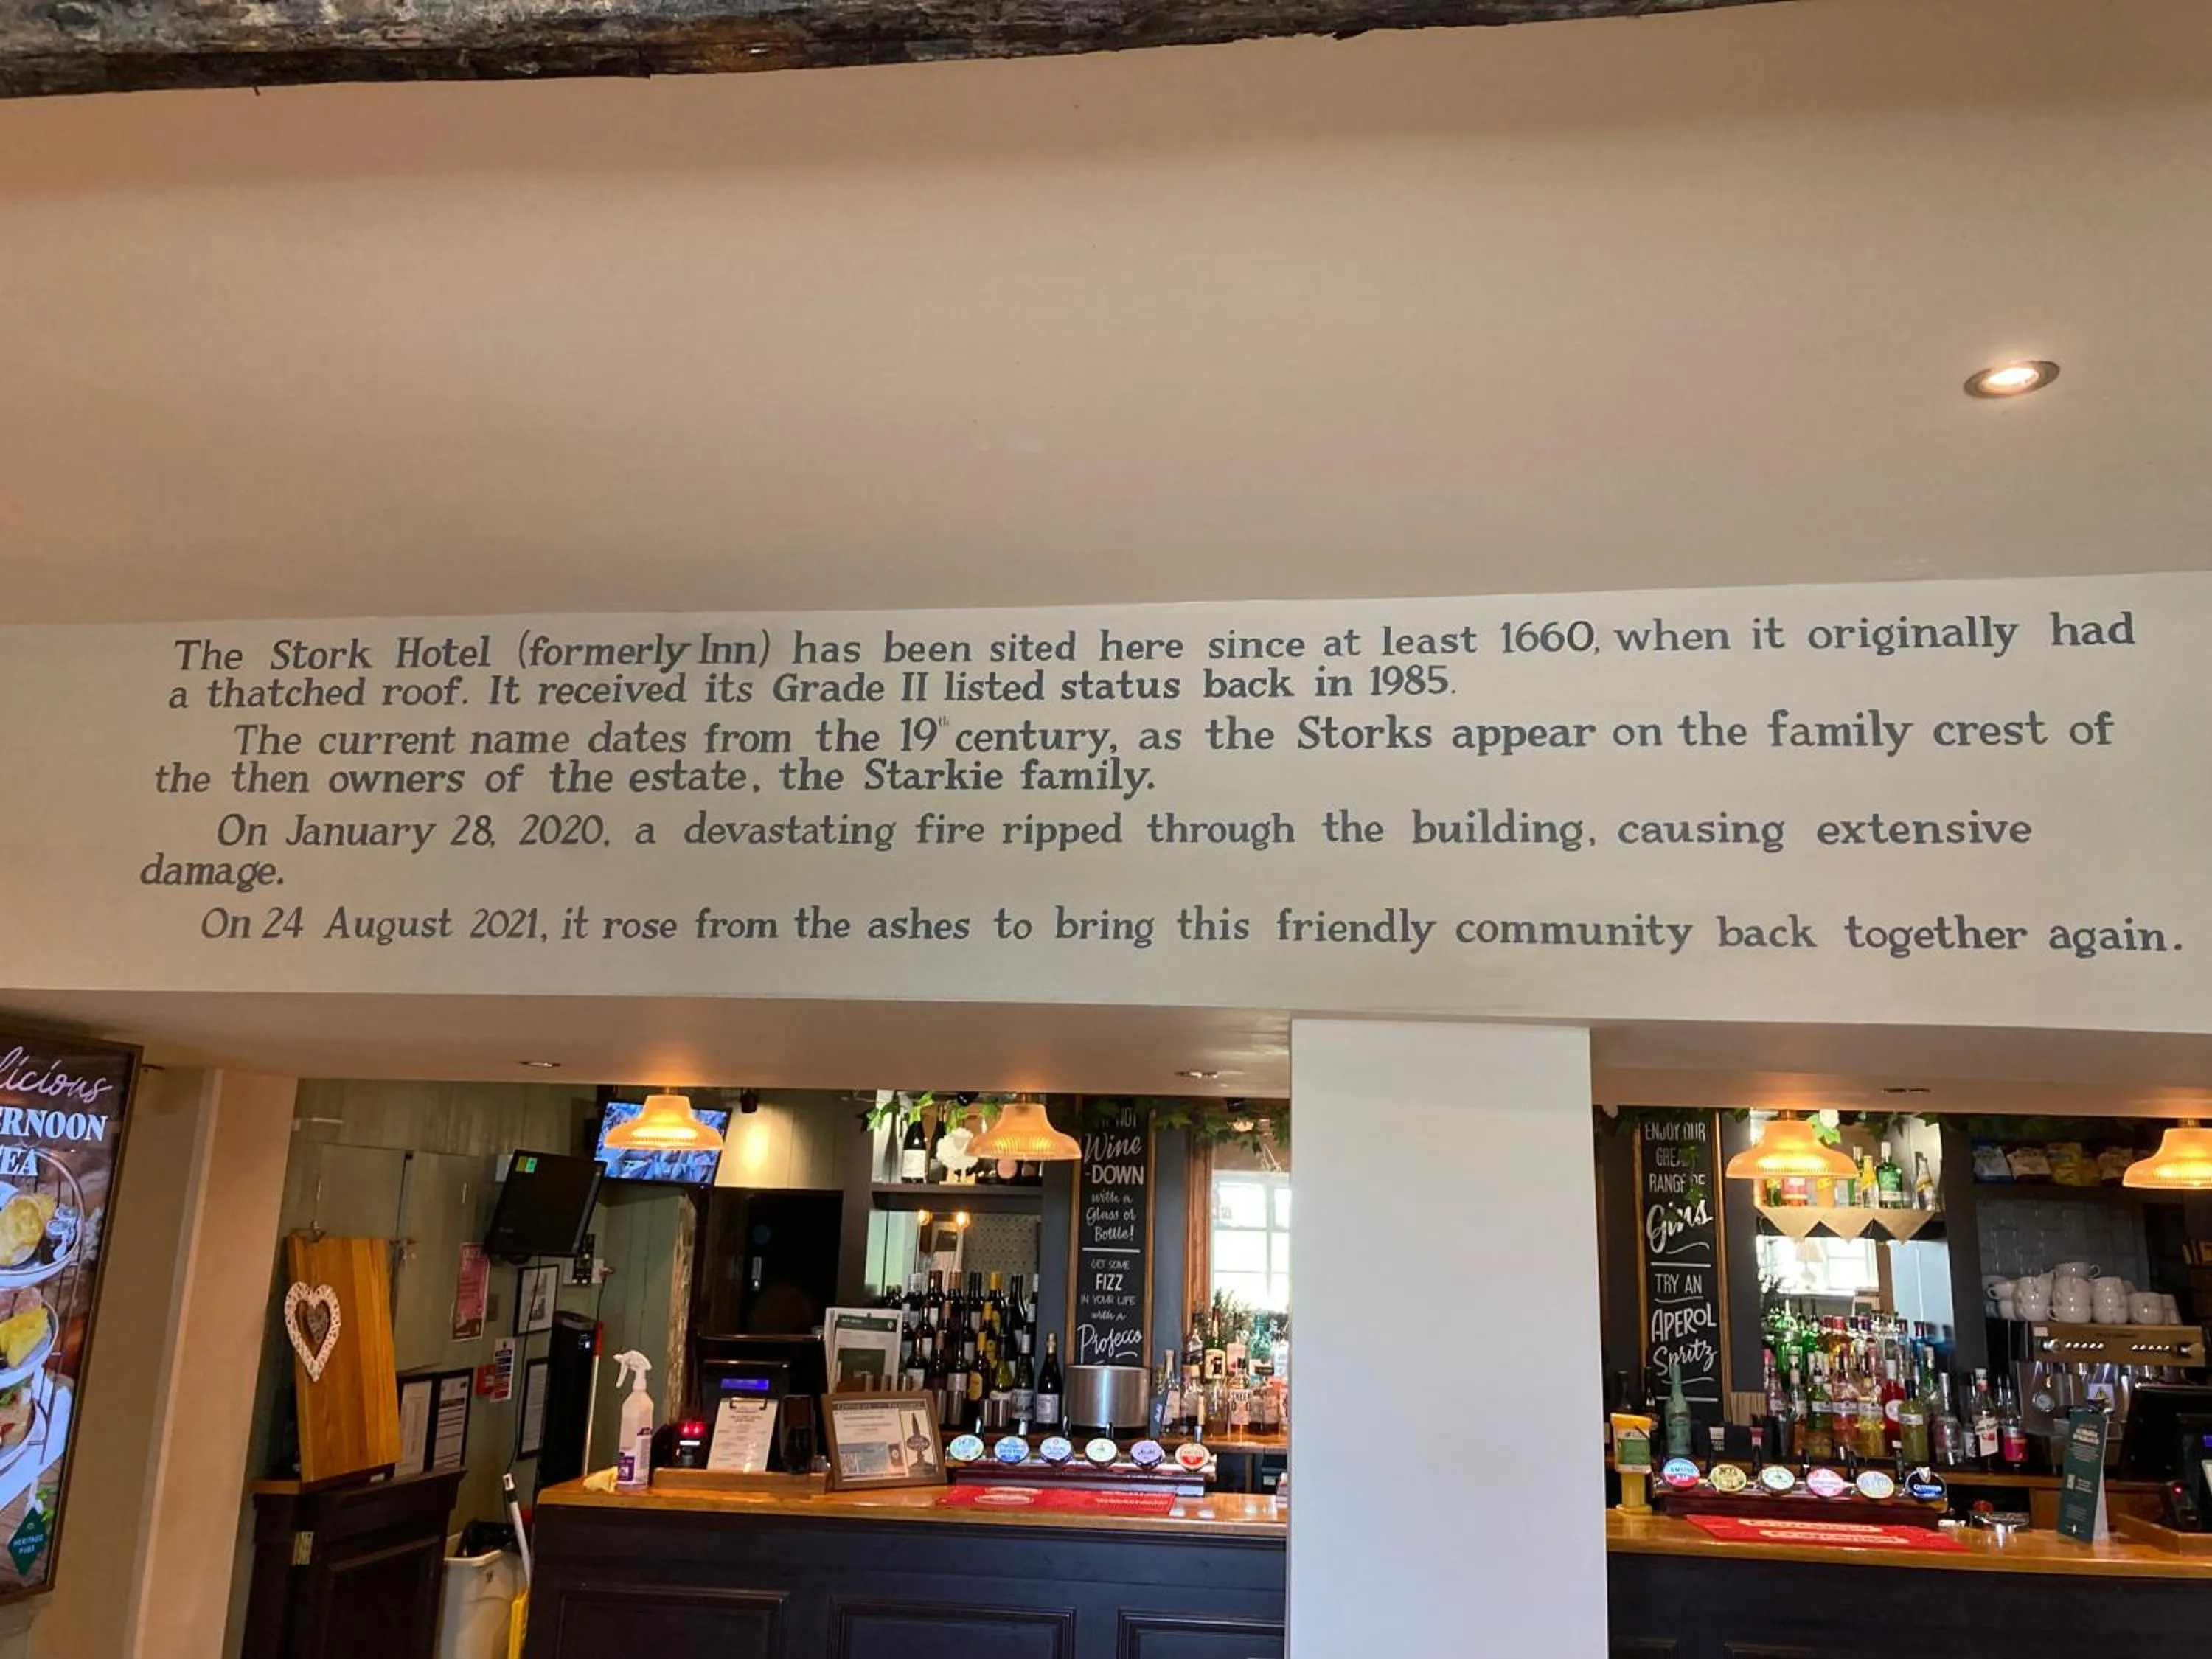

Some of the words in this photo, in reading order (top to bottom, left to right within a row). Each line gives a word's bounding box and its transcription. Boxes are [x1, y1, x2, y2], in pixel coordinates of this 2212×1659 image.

[174, 639, 243, 671] The
[270, 638, 373, 671] Stork
[394, 634, 491, 669] Hotel
[518, 629, 693, 675] (formerly
[698, 628, 771, 669] Inn)
[791, 630, 861, 664] has
[883, 630, 973, 663] been
[990, 630, 1076, 663] sited
[1099, 628, 1183, 661] here
[1208, 629, 1306, 660] since
[1323, 629, 1362, 658] at
[1381, 625, 1478, 656] least
[1500, 620, 1600, 655] 1660,
[1613, 617, 1731, 652] when
[1752, 616, 1786, 650] it
[1808, 615, 2020, 658] originally
[2049, 611, 2136, 647] had
[168, 686, 189, 709] a
[206, 675, 366, 709] thatched
[381, 674, 468, 706] roof.
[488, 675, 521, 706] It
[538, 672, 688, 706] received
[704, 672, 754, 703] its
[772, 672, 886, 703] Grade
[900, 671, 930, 702] II
[943, 668, 1046, 702] listed
[1060, 669, 1180, 701] status
[1203, 666, 1295, 698] back
[1315, 664, 1353, 697] in
[1369, 664, 1456, 696] 1985.
[234, 723, 302, 756] The
[318, 726, 456, 756] current
[469, 731, 570, 755] name
[588, 719, 687, 754] dates
[703, 722, 792, 754] from
[815, 717, 880, 753] the
[955, 720, 1118, 759] century,
[1138, 728, 1183, 751] as
[1204, 714, 1275, 750] the
[1297, 713, 1433, 751] Storks
[1452, 724, 1597, 757] appear
[1612, 723, 1663, 747] on
[1677, 710, 1747, 747] the
[1767, 709, 1914, 758] family
[1933, 709, 2049, 747] crest
[2069, 710, 2115, 745] of
[155, 761, 211, 793] the
[230, 760, 310, 794] then
[328, 769, 465, 793] owners
[484, 762, 525, 793] of
[548, 758, 613, 794] the
[628, 759, 760, 793] estate,
[778, 756, 844, 791] the
[864, 757, 1004, 791] Starkie
[1020, 756, 1155, 801] family.
[217, 813, 268, 846] On
[285, 813, 437, 855] January
[449, 813, 496, 849] 28,
[634, 822, 656, 844] a
[684, 810, 897, 852] devastating
[914, 812, 985, 844] fire
[1002, 811, 1123, 852] ripped
[1146, 812, 1295, 852] through
[1321, 808, 1384, 843] the
[1411, 807, 1596, 852] building,
[1617, 810, 1785, 854] causing
[1816, 809, 2032, 846] extensive
[139, 852, 284, 894] damage.
[201, 906, 251, 939] On
[261, 905, 304, 939] 24
[322, 906, 453, 947] August
[469, 908, 548, 943] 2021,
[560, 905, 589, 940] it
[602, 918, 678, 940] rose
[694, 906, 779, 939] from
[793, 905, 851, 939] the
[867, 906, 970, 941] ashes
[993, 908, 1033, 940] to
[1054, 905, 1155, 950] bring
[1176, 904, 1250, 941] this
[1276, 907, 1438, 955] friendly
[1455, 913, 1694, 956] community
[1716, 913, 1818, 948] back
[1843, 914, 2028, 959] together
[2048, 916, 2183, 959] again.
[0, 1107, 108, 1141] RNOON
[1644, 1121, 1679, 1141] ENJOY
[1683, 1122, 1706, 1141] OUR
[0, 1146, 38, 1176] EA
[1084, 1133, 1143, 1165] Wine
[1656, 1147, 1695, 1167] GRE
[1649, 1173, 1686, 1193] RANGE
[1086, 1207, 1119, 1226] Glass
[1646, 1199, 1714, 1253] Gins
[1096, 1273, 1123, 1291] FIZZ
[1655, 1273, 1679, 1293] TRY
[1685, 1274, 1703, 1294] AN
[1651, 1302, 1717, 1343] APEROL
[1077, 1324, 1142, 1364] Prosecco
[1652, 1340, 1718, 1377] Spritz
